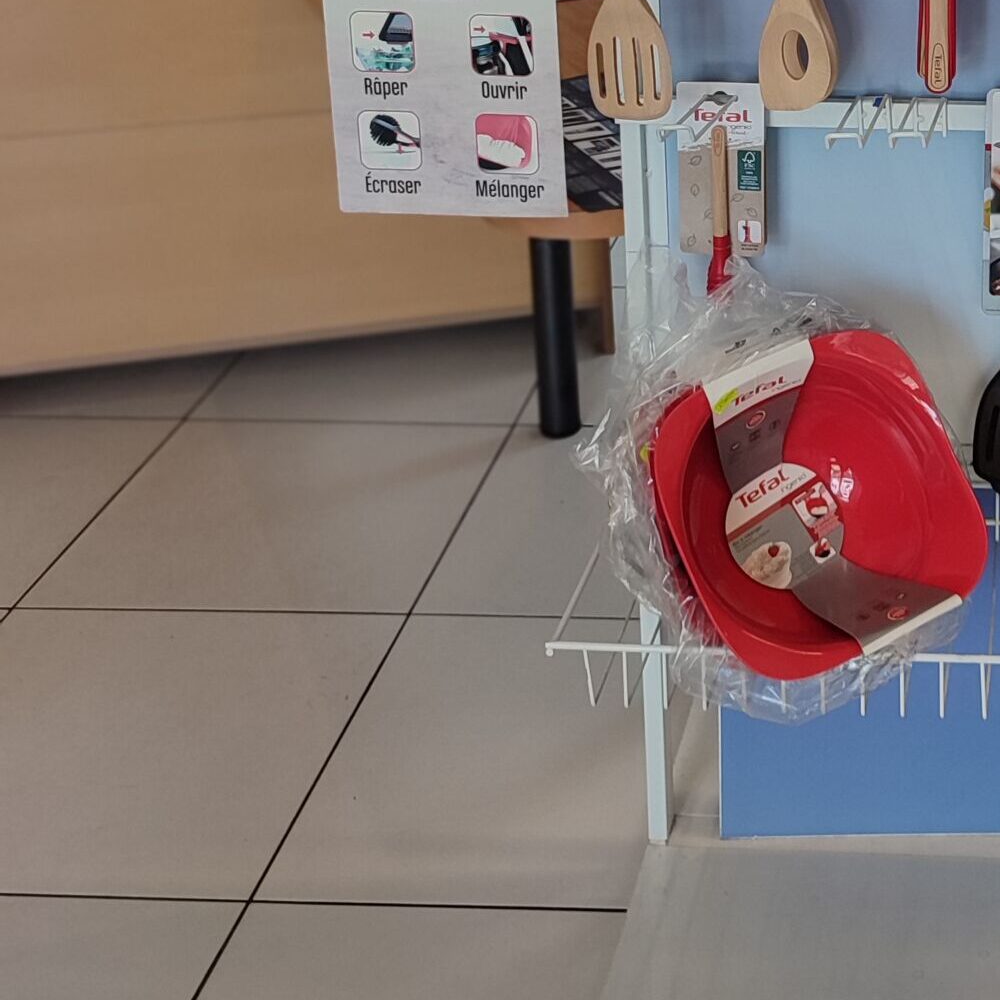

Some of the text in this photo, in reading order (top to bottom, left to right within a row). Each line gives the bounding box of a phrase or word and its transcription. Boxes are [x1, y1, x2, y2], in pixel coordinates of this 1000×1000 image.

[935, 54, 943, 84] Tefal
[363, 77, 408, 100] Râper
[481, 81, 528, 100] Ouvrir
[365, 171, 422, 194] Écraser
[475, 179, 545, 203] Mélanger
[735, 469, 791, 508] Tefal
